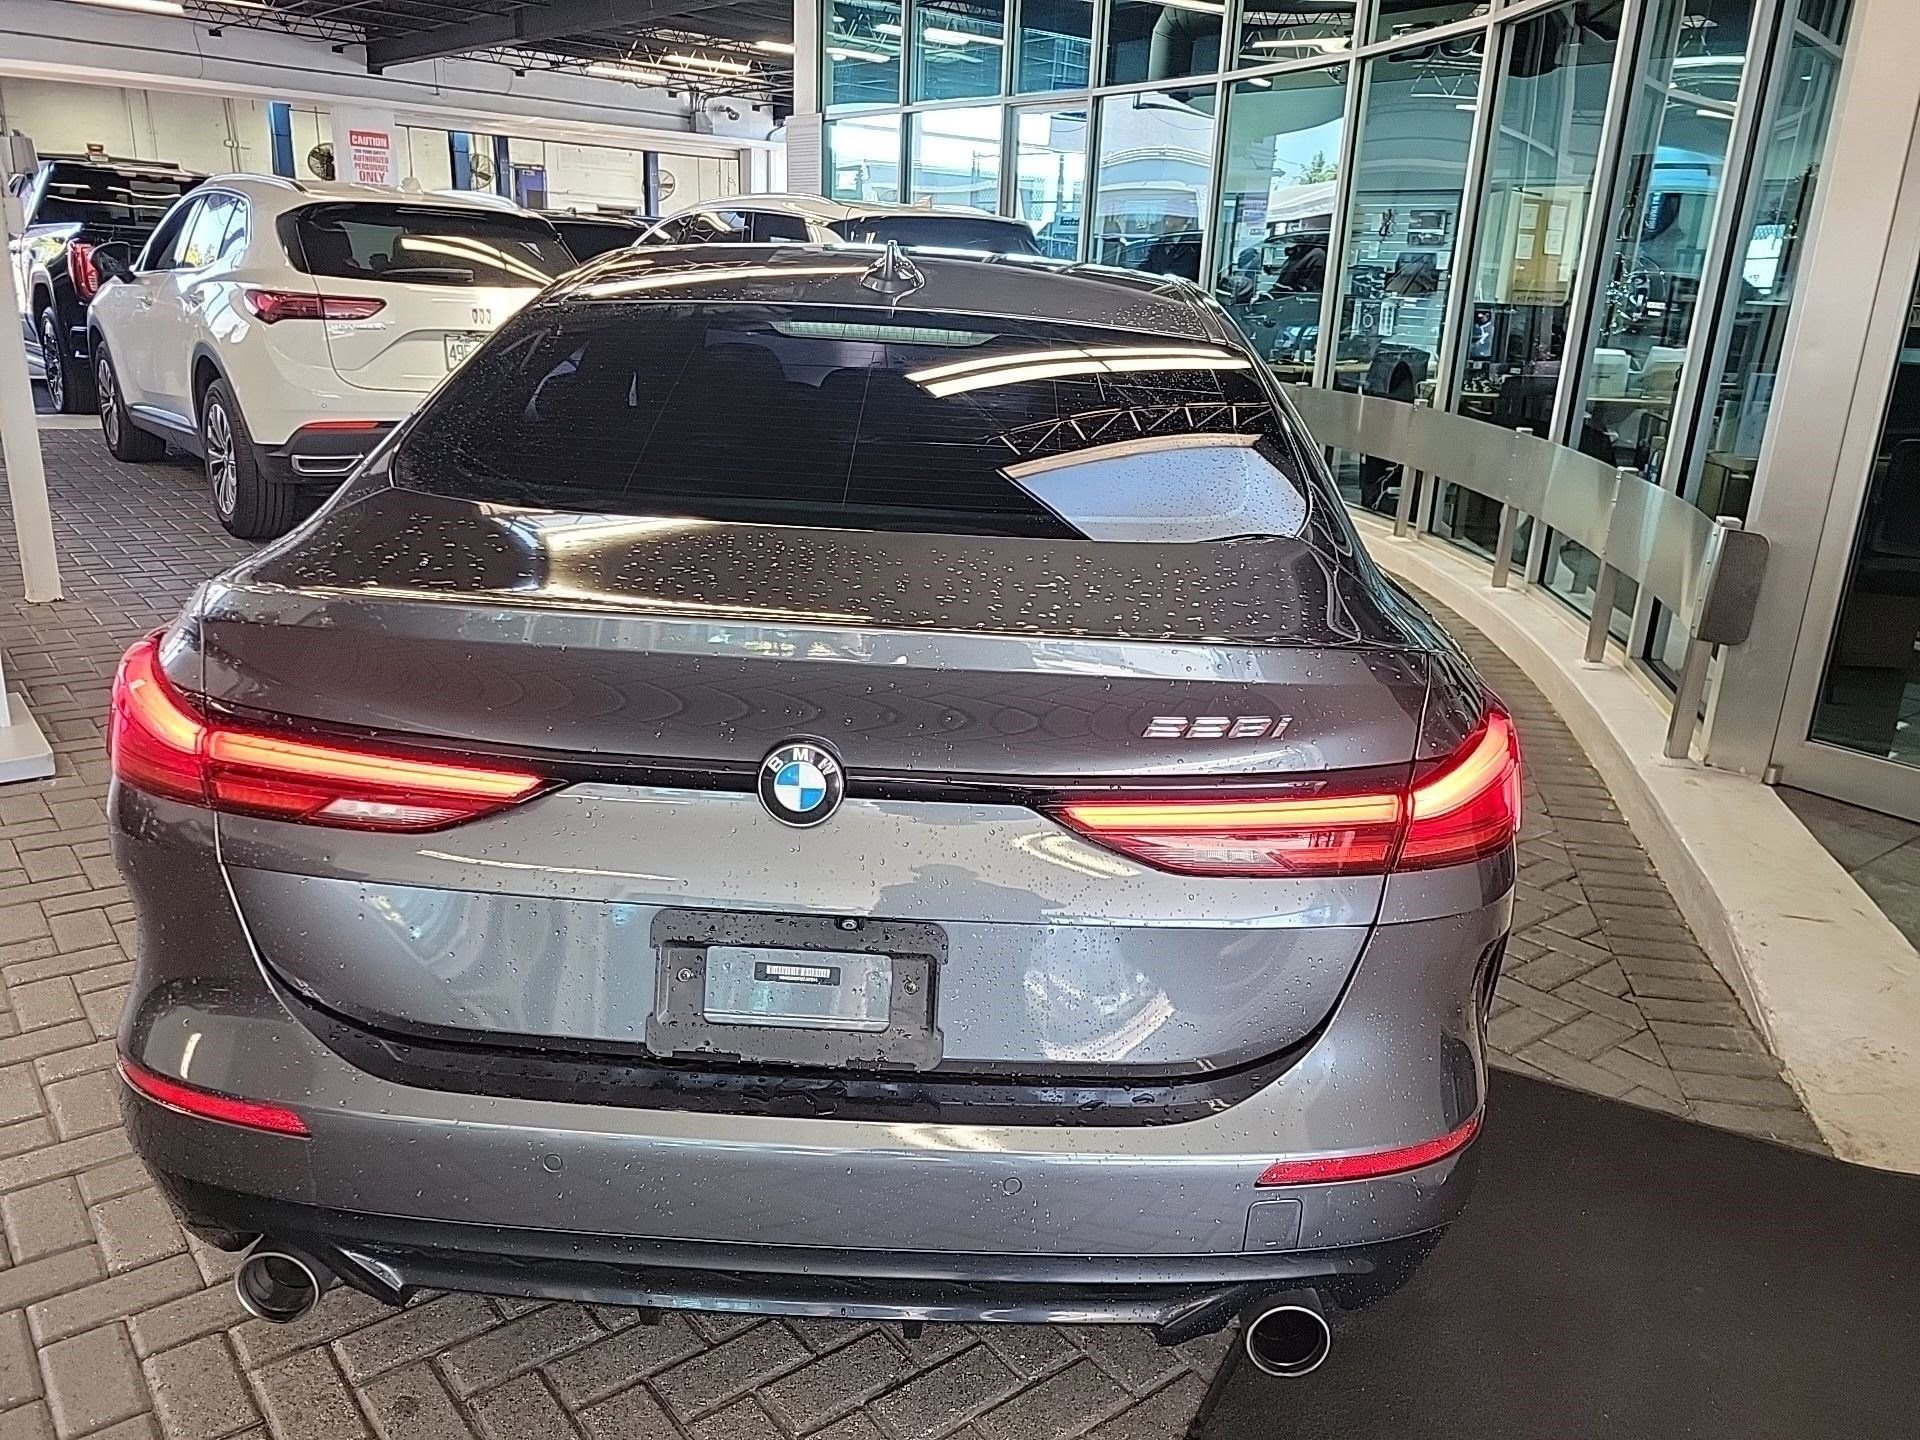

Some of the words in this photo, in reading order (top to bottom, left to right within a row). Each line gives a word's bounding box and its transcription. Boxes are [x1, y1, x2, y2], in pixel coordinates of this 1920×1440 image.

[351, 134, 387, 147] CAUTION
[353, 154, 389, 165] AUTHORIZED
[354, 162, 389, 173] PERSONNEL
[359, 170, 385, 184] ONLY
[1141, 714, 1294, 740] 228i
[767, 747, 836, 776] BMW
